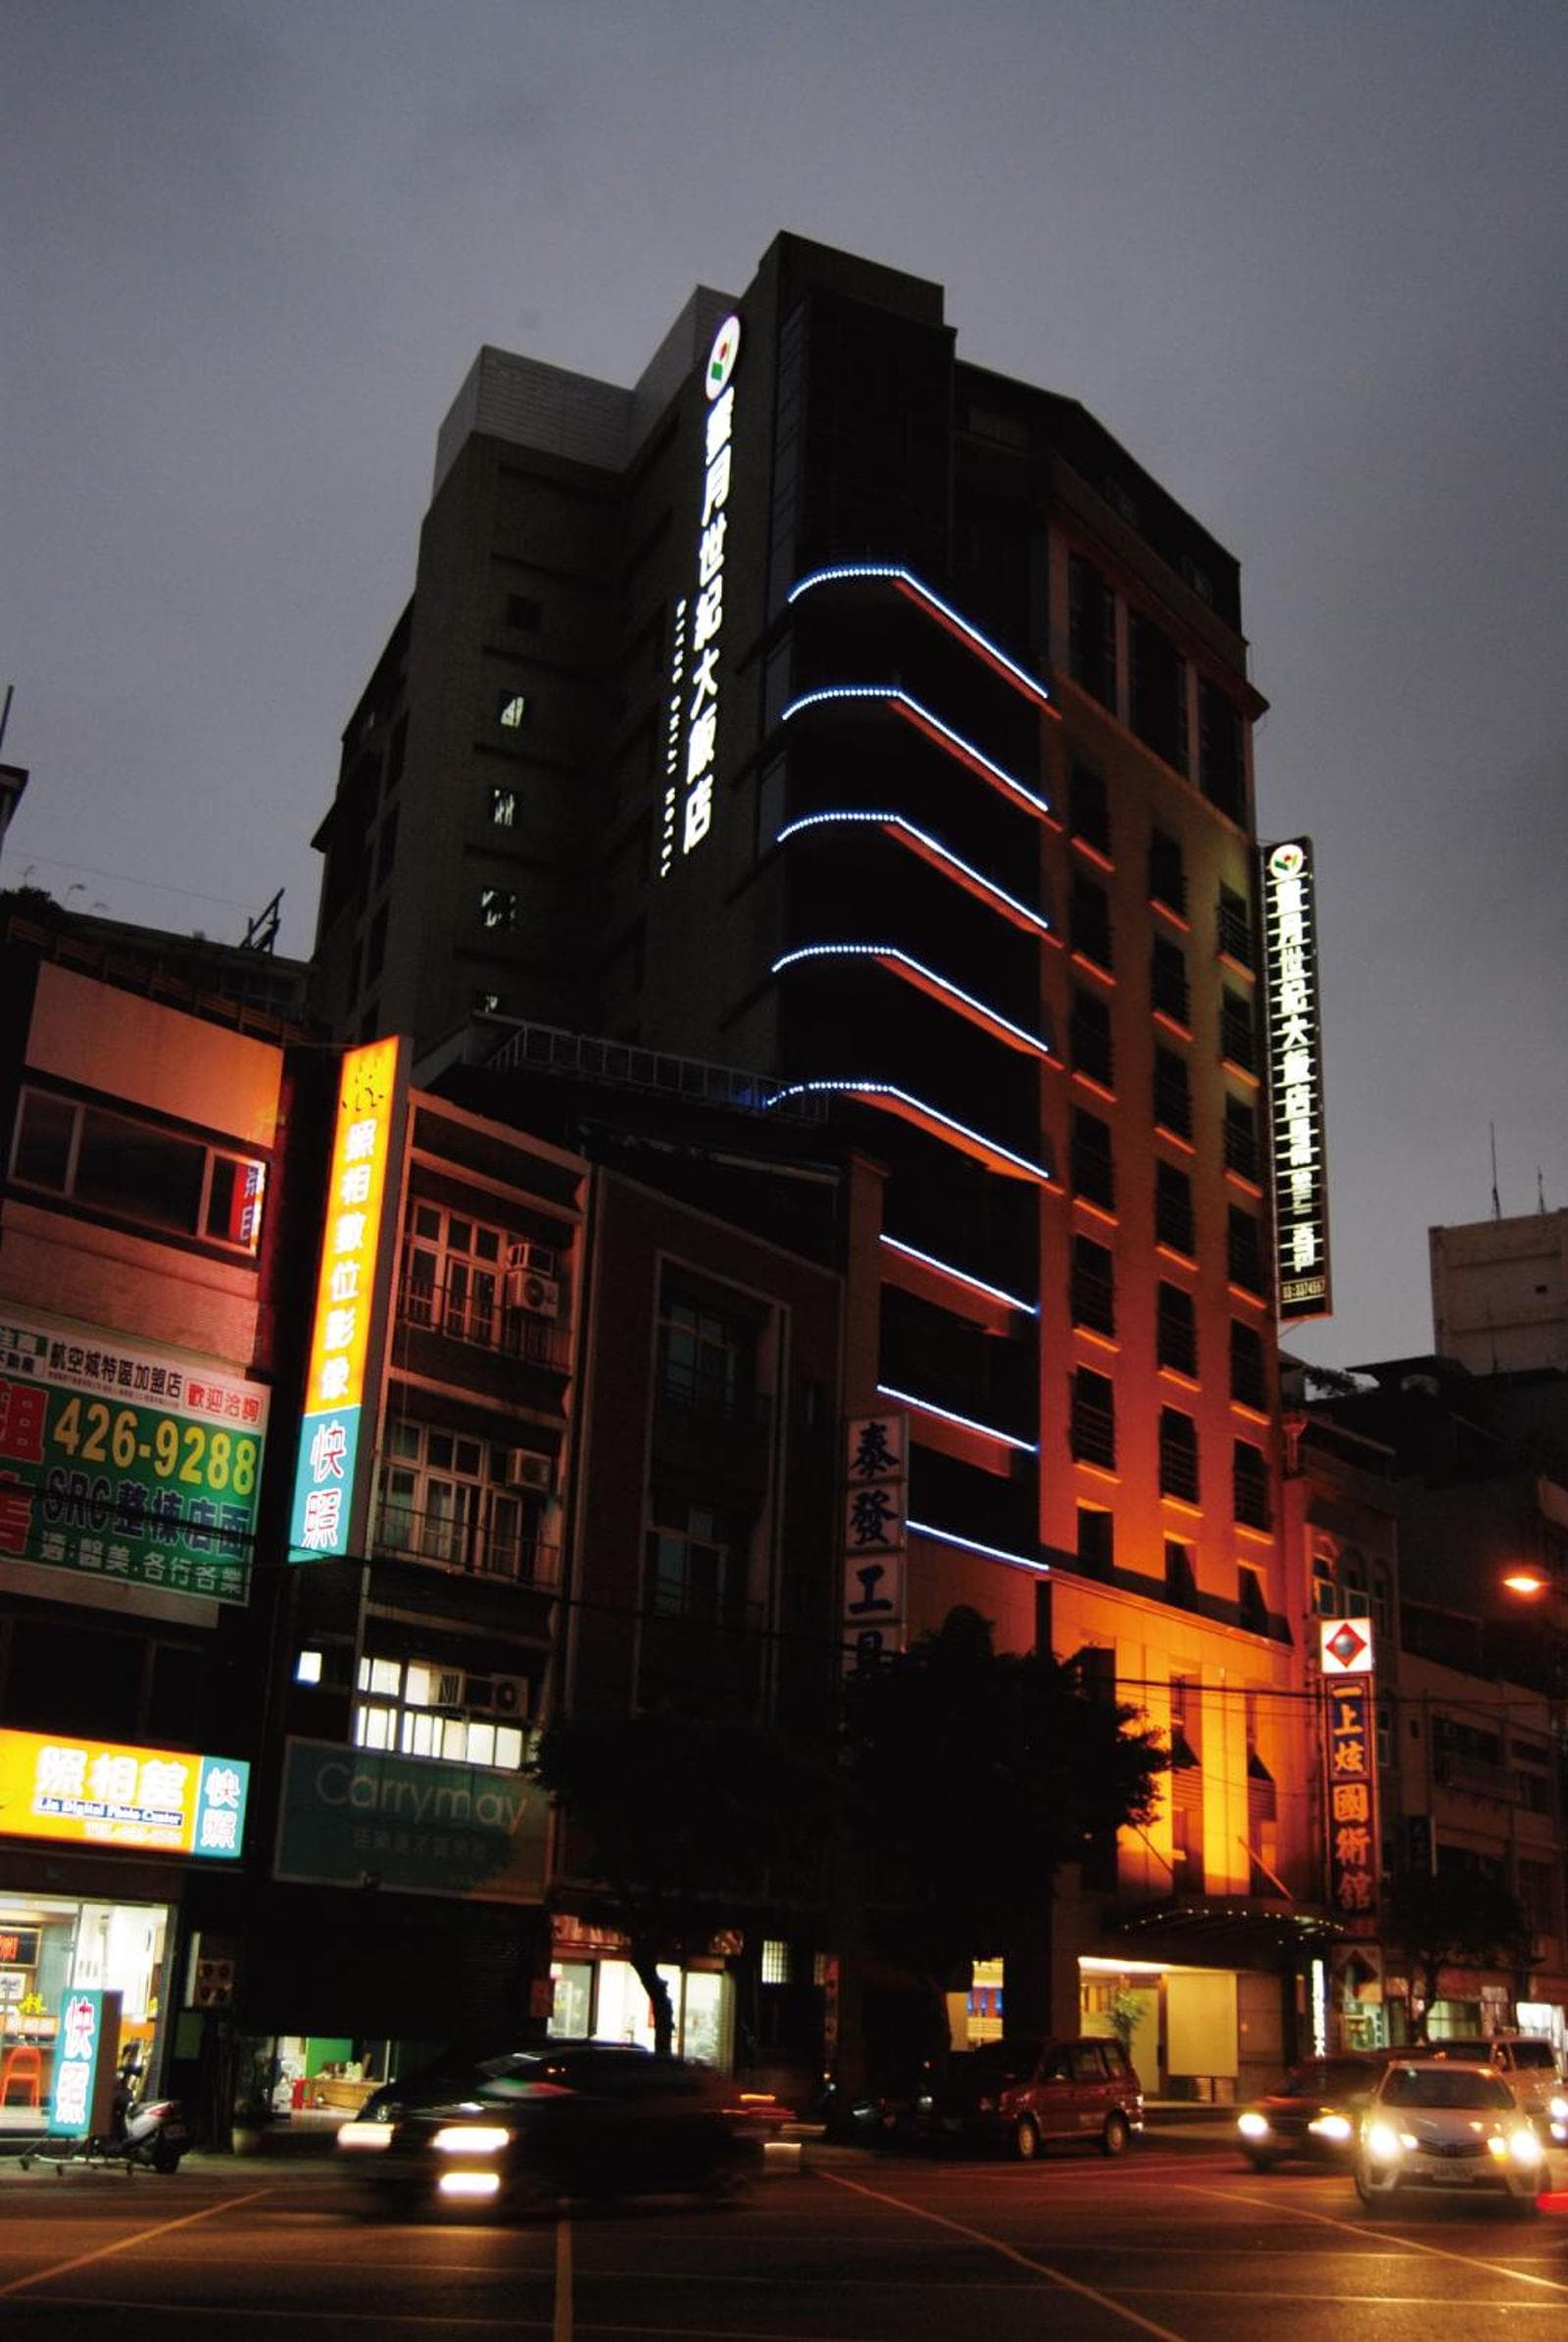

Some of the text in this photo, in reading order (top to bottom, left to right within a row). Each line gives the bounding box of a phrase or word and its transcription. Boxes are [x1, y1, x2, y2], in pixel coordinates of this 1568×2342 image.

[50, 1342, 183, 1399] 航空城特區加盟店
[53, 1397, 257, 1495] 426-9288
[301, 1419, 345, 1548] 快照
[35, 1745, 189, 1809] 照相館
[199, 1766, 242, 1850] 快照
[315, 1763, 528, 1835] Carrymay
